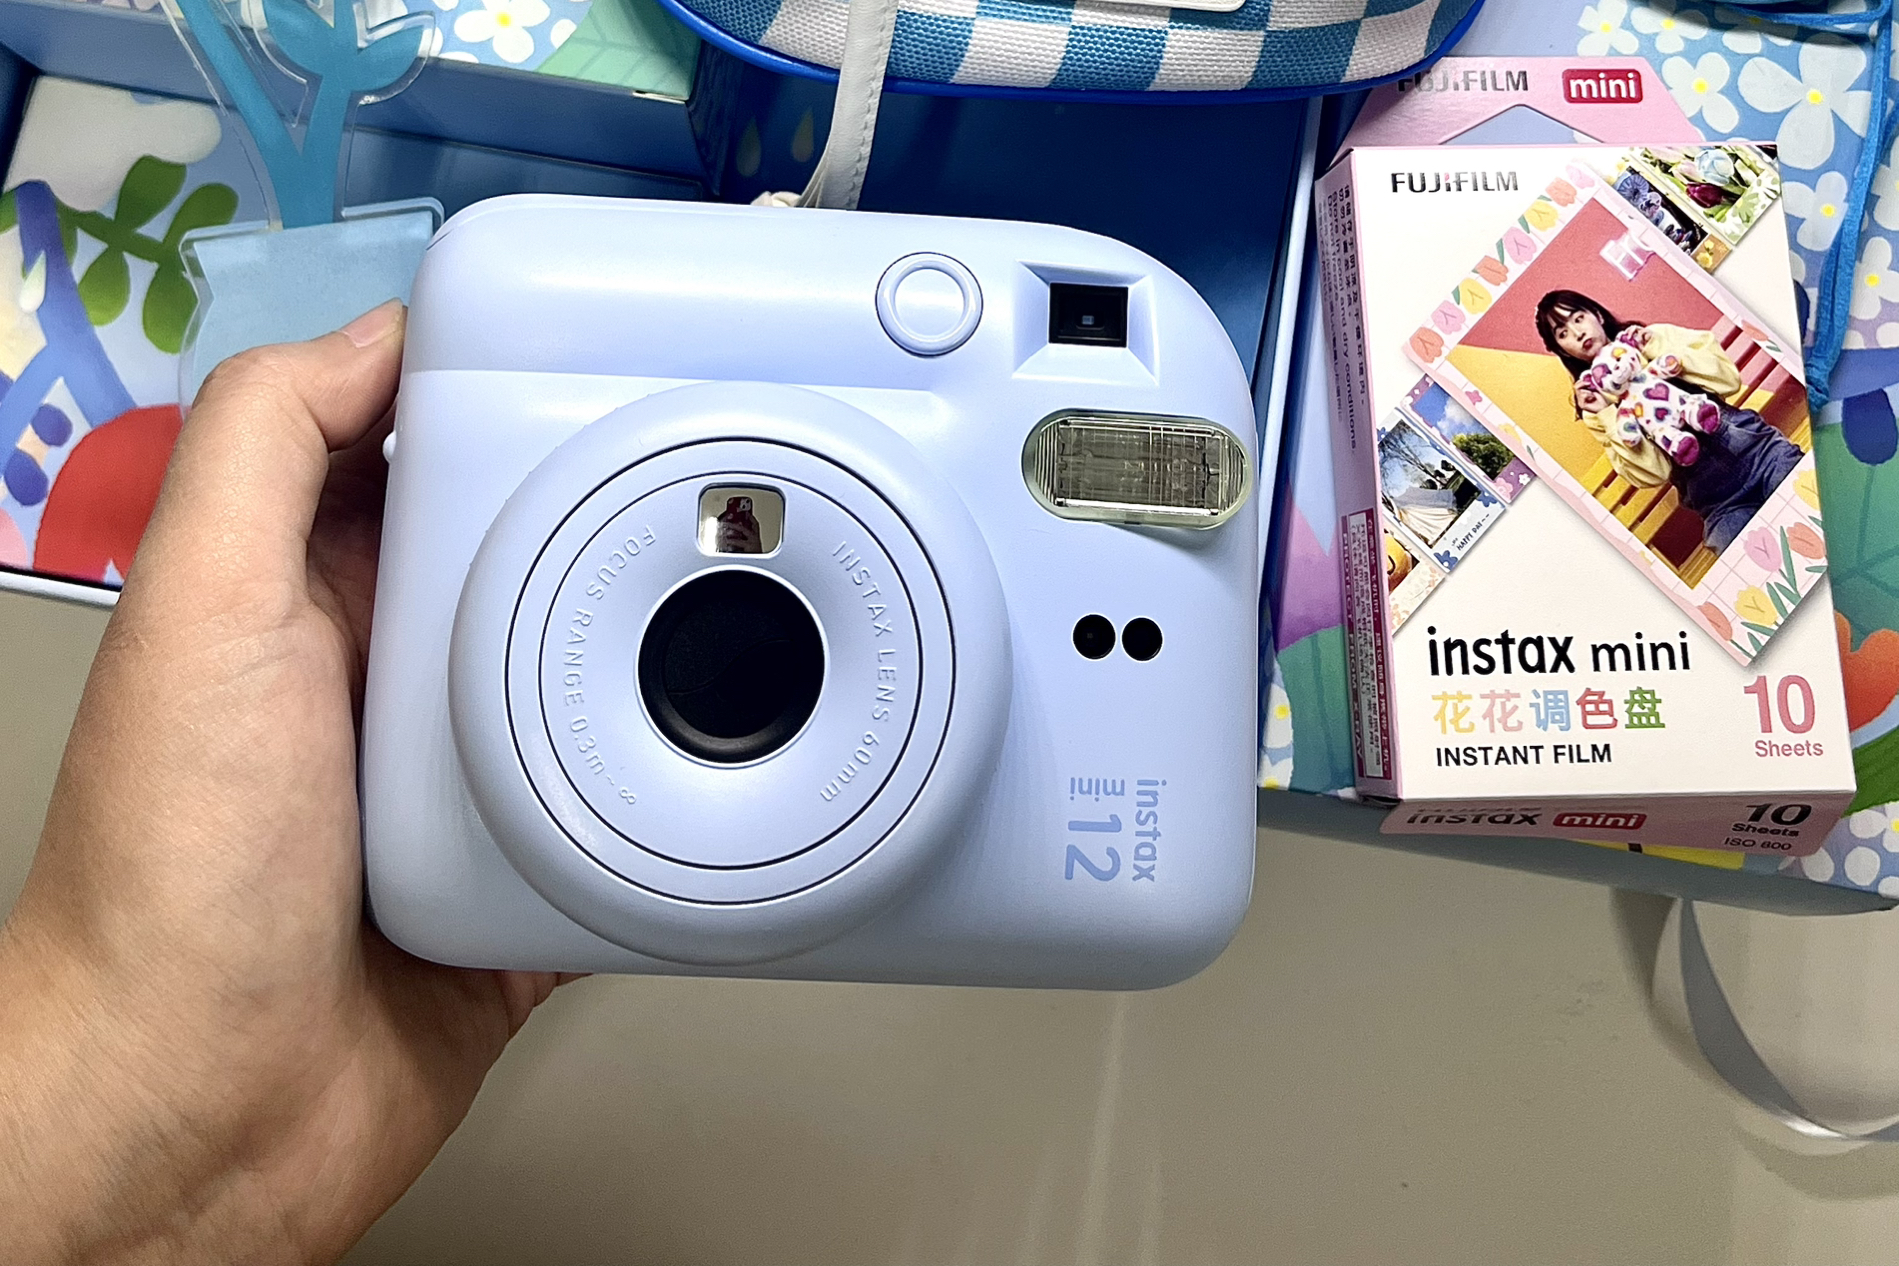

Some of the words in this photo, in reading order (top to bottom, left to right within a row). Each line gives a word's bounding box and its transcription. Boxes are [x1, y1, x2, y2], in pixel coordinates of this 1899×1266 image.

[1397, 70, 1529, 92] FUJIFILM
[1569, 72, 1636, 99] mini
[1391, 171, 1519, 193] FUJIFILM
[1341, 330, 1349, 359] dry
[586, 525, 657, 600] FOCUS
[832, 540, 894, 638] INSTAX
[563, 608, 594, 706] RANGE
[1426, 626, 1576, 676] instax
[1591, 630, 1691, 672] mini
[872, 648, 897, 723] LENS
[1743, 674, 1816, 735] 10
[1431, 686, 1667, 735] 花花调色盘
[820, 730, 880, 803] 60mm
[1436, 744, 1545, 767] INSTANT
[1552, 743, 1613, 765] FILM
[1754, 740, 1824, 759] Sheets
[1069, 777, 1126, 803] mini
[1131, 779, 1167, 883] instax
[1406, 812, 1543, 826] instax
[1561, 814, 1639, 828] mini
[1731, 823, 1800, 837] Sheets
[1745, 803, 1812, 826] 10
[1064, 813, 1122, 882] 12
[1723, 837, 1756, 848] ISO
